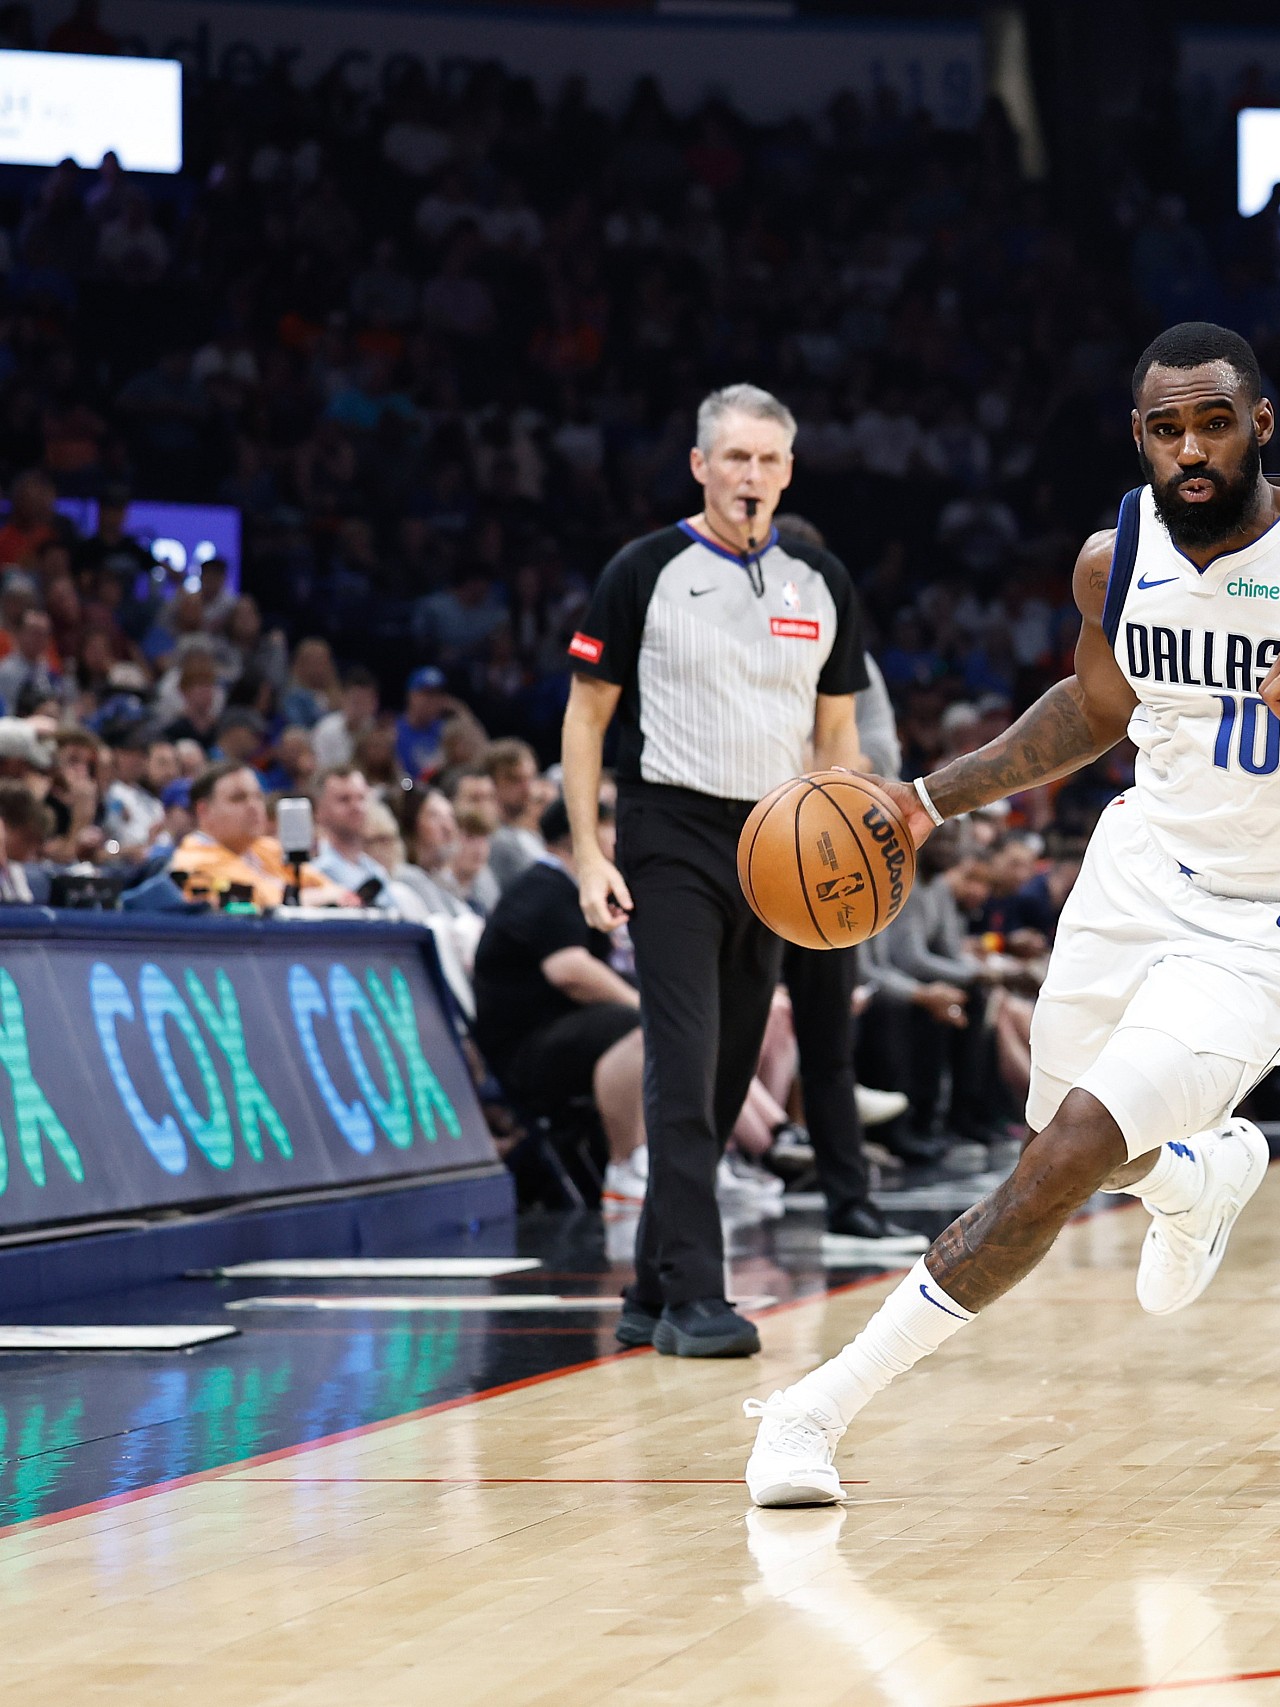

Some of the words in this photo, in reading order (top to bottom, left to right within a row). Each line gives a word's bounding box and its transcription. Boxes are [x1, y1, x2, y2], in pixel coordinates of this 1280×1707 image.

[1226, 577, 1280, 600] chime
[862, 802, 906, 920] Wilson
[90, 962, 294, 1175] COX
[288, 962, 463, 1155] COX
